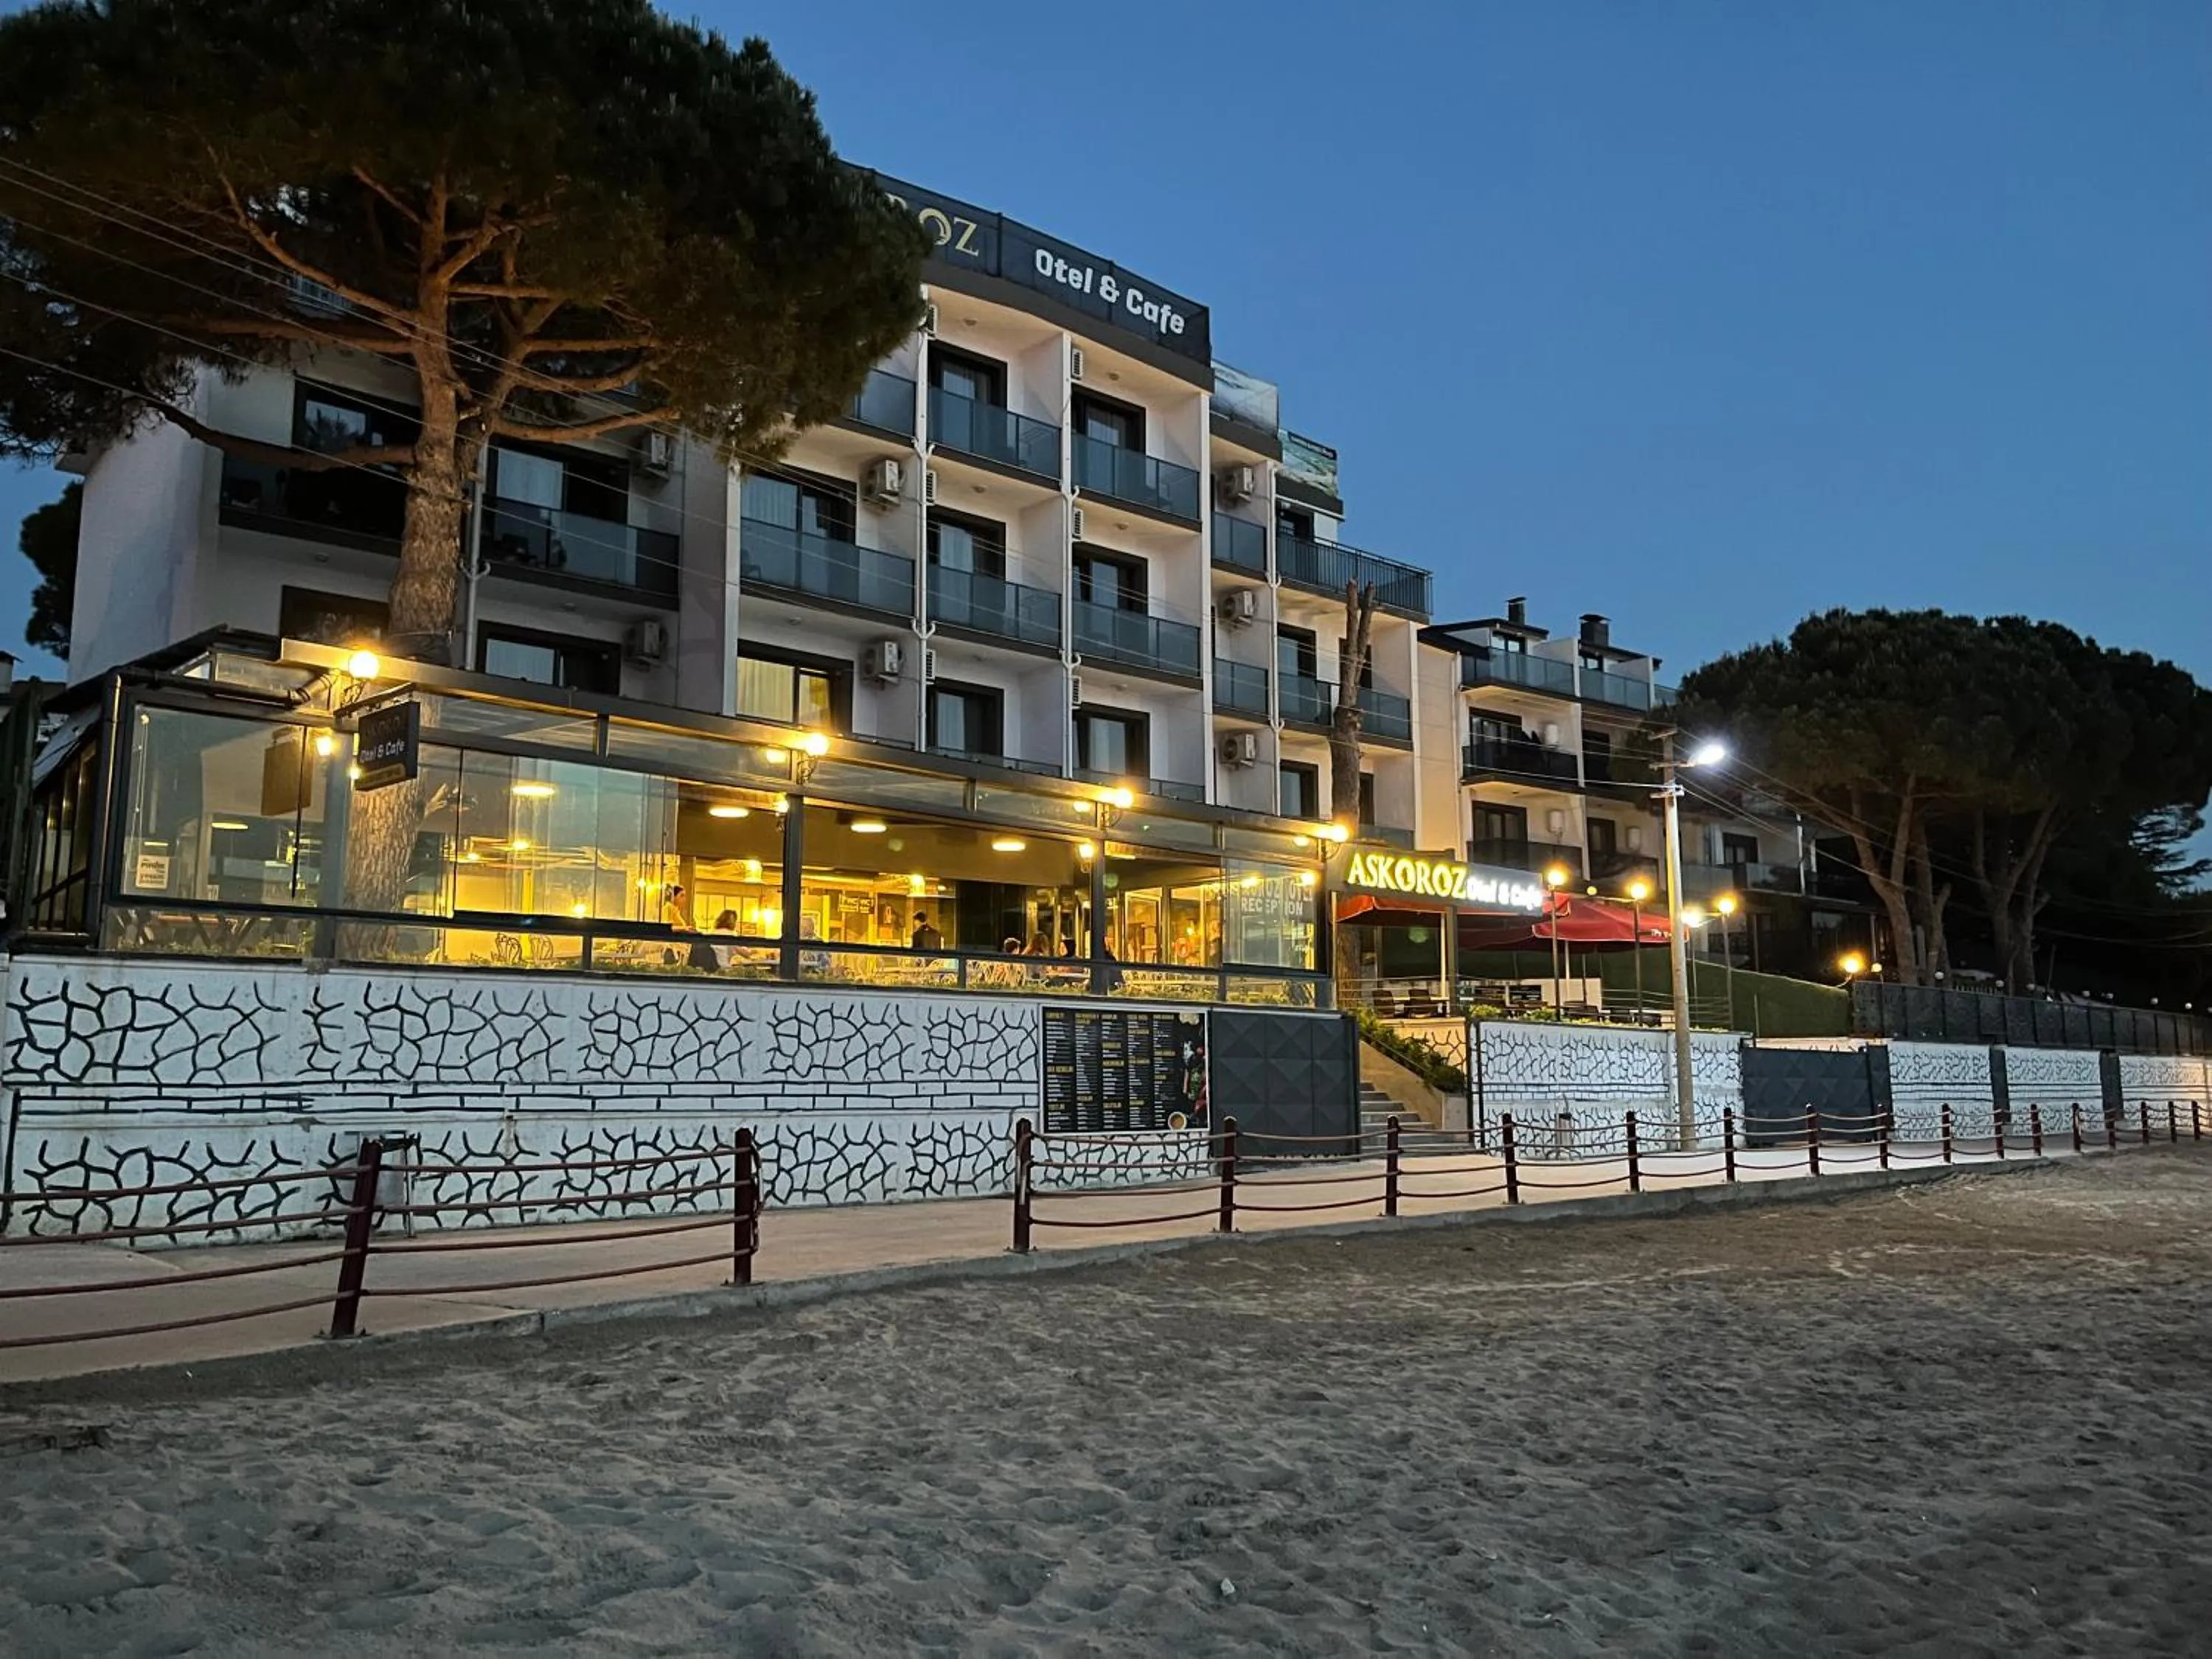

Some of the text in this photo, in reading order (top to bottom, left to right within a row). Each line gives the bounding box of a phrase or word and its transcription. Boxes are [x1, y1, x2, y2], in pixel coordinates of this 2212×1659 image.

[1034, 248, 1185, 335] Otel & Cafe
[386, 739, 405, 756] Cafe
[1347, 851, 1468, 900] ASKOROZ
[1242, 897, 1303, 916] RECEPION
